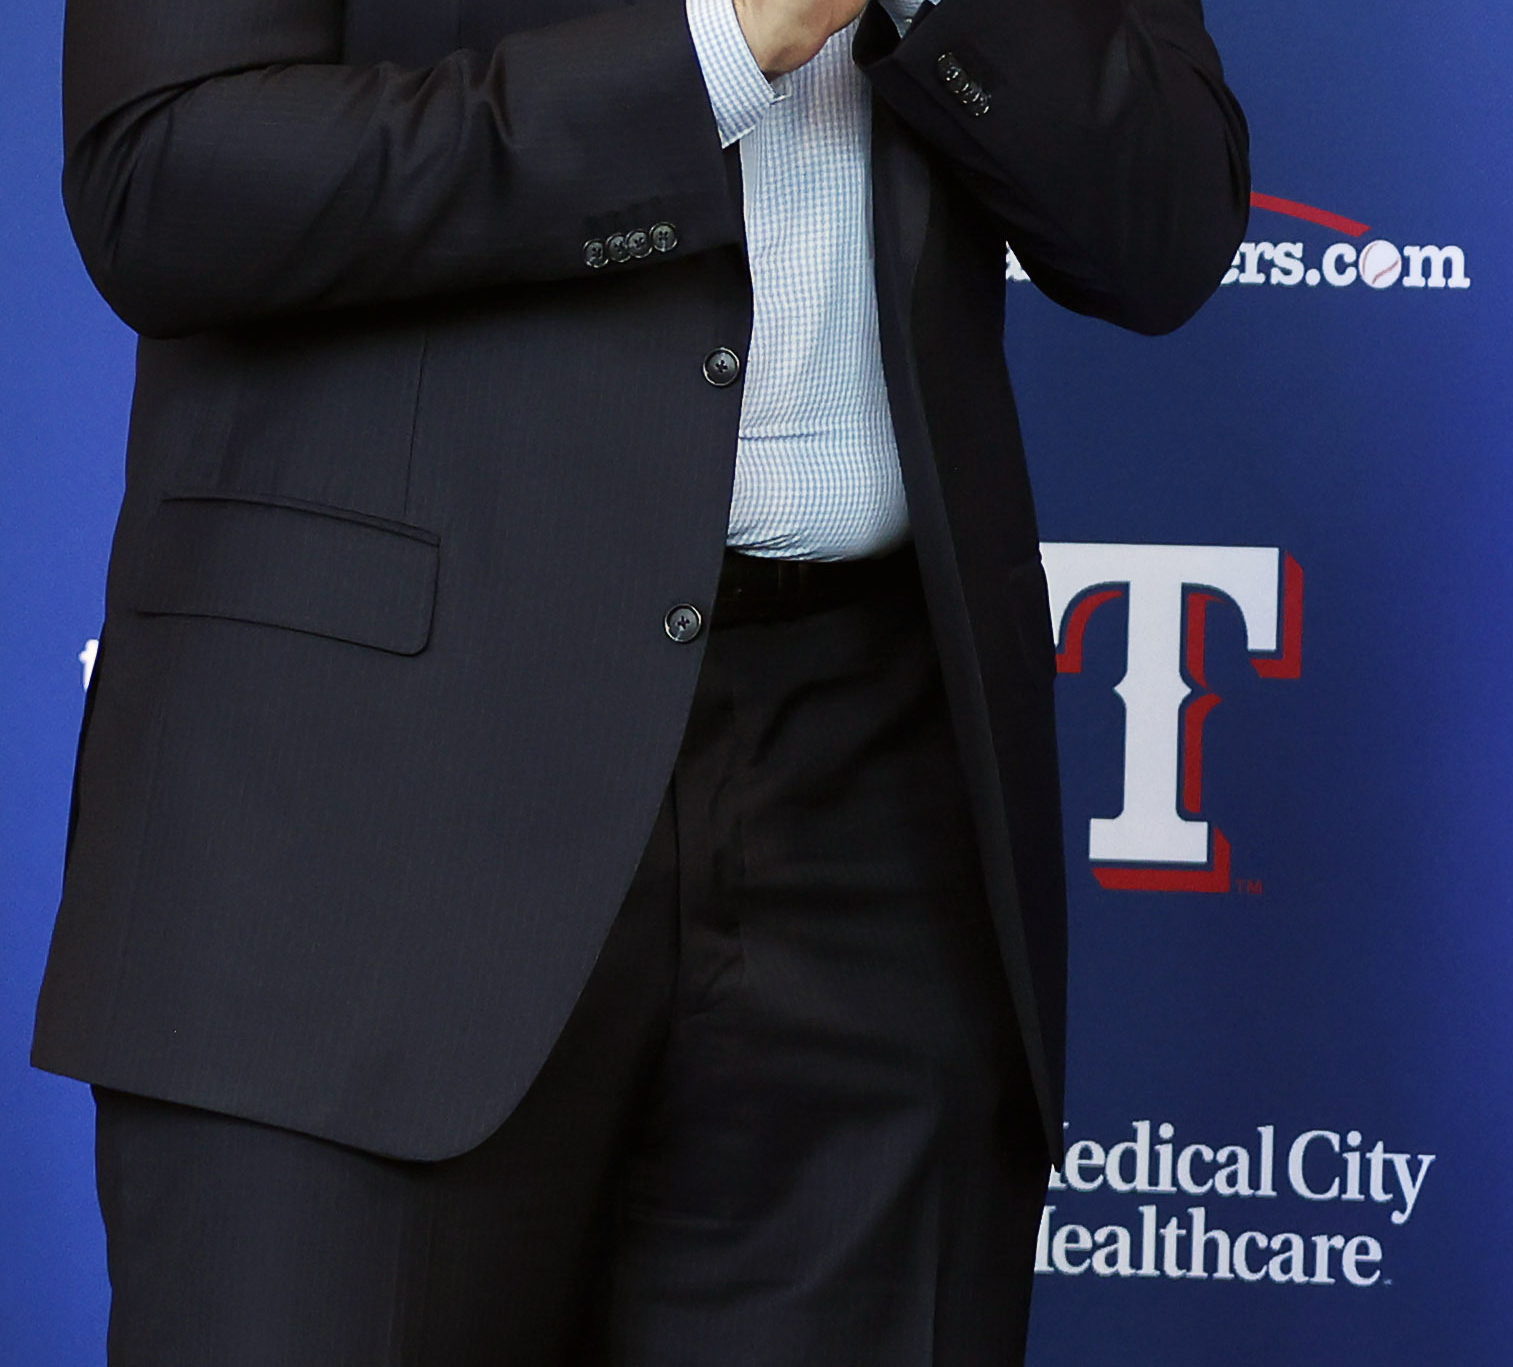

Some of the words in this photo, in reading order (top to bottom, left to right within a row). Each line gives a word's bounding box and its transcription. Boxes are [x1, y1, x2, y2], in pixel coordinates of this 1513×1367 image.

[1040, 541, 1305, 893] T
[1048, 1120, 1277, 1196] edical
[1288, 1130, 1436, 1224] City
